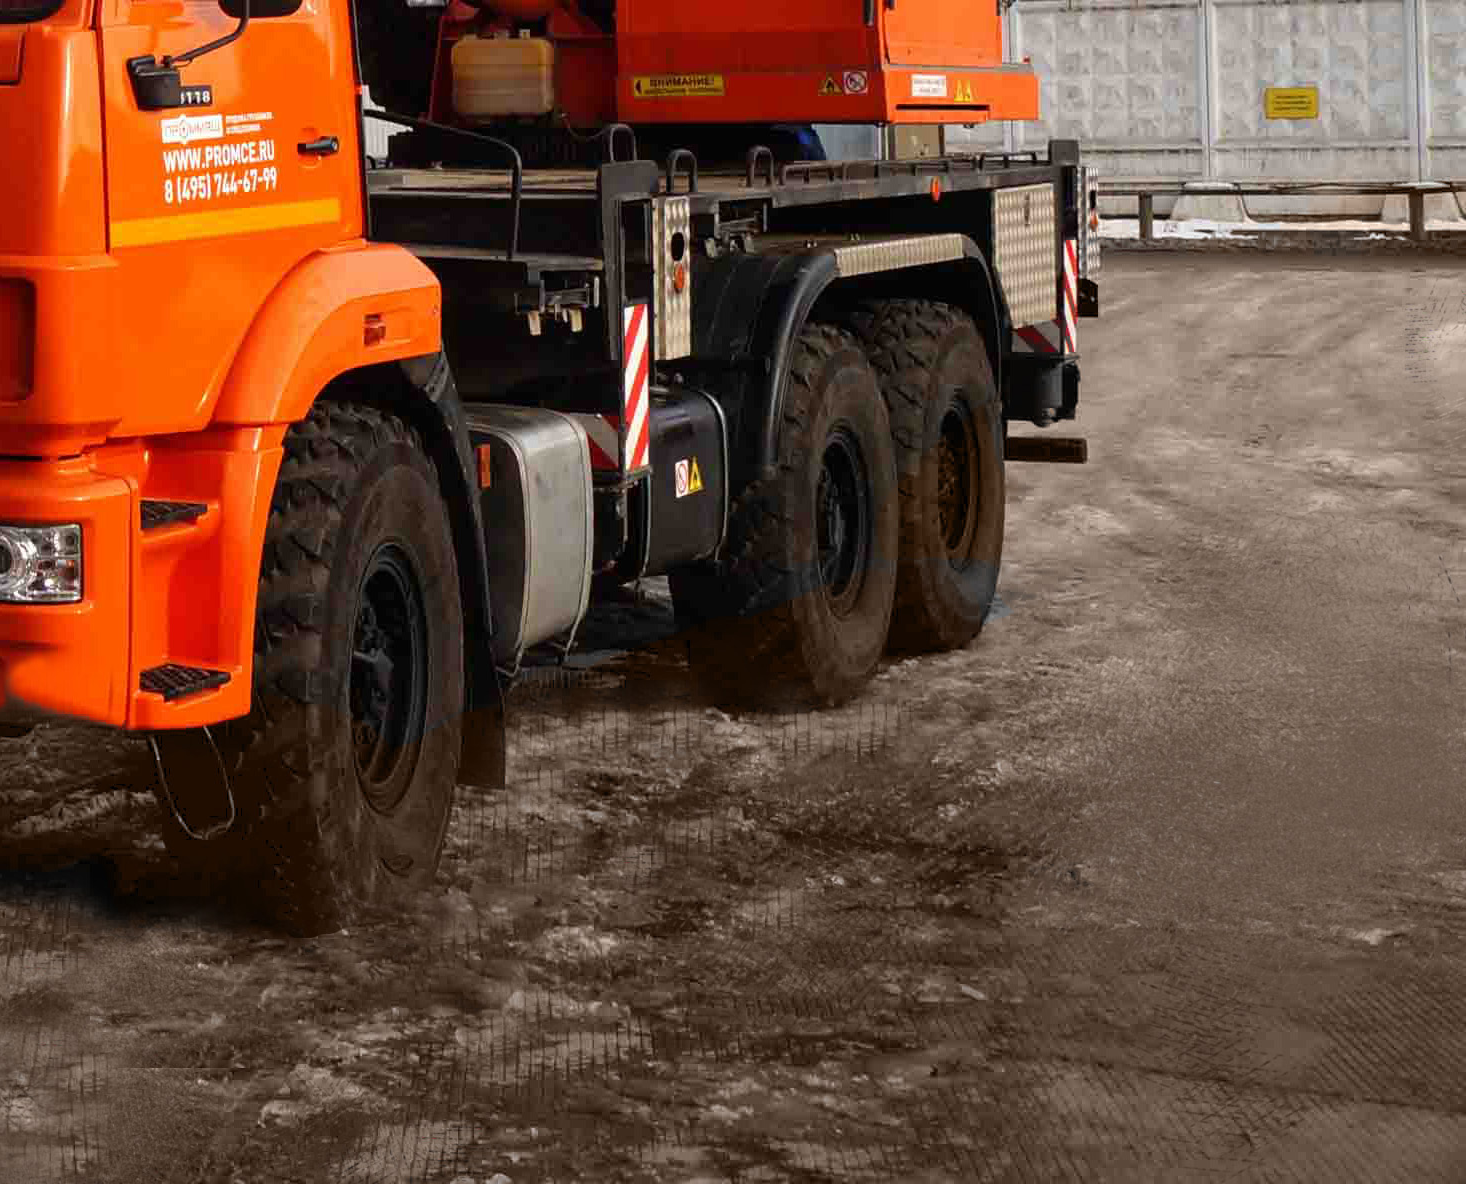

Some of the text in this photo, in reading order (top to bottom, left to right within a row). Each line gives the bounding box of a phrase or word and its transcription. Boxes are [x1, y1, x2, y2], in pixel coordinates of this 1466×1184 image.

[163, 140, 275, 173] WWW.PROMCE.RU
[164, 167, 278, 205] 8 (495) 744-67-99
